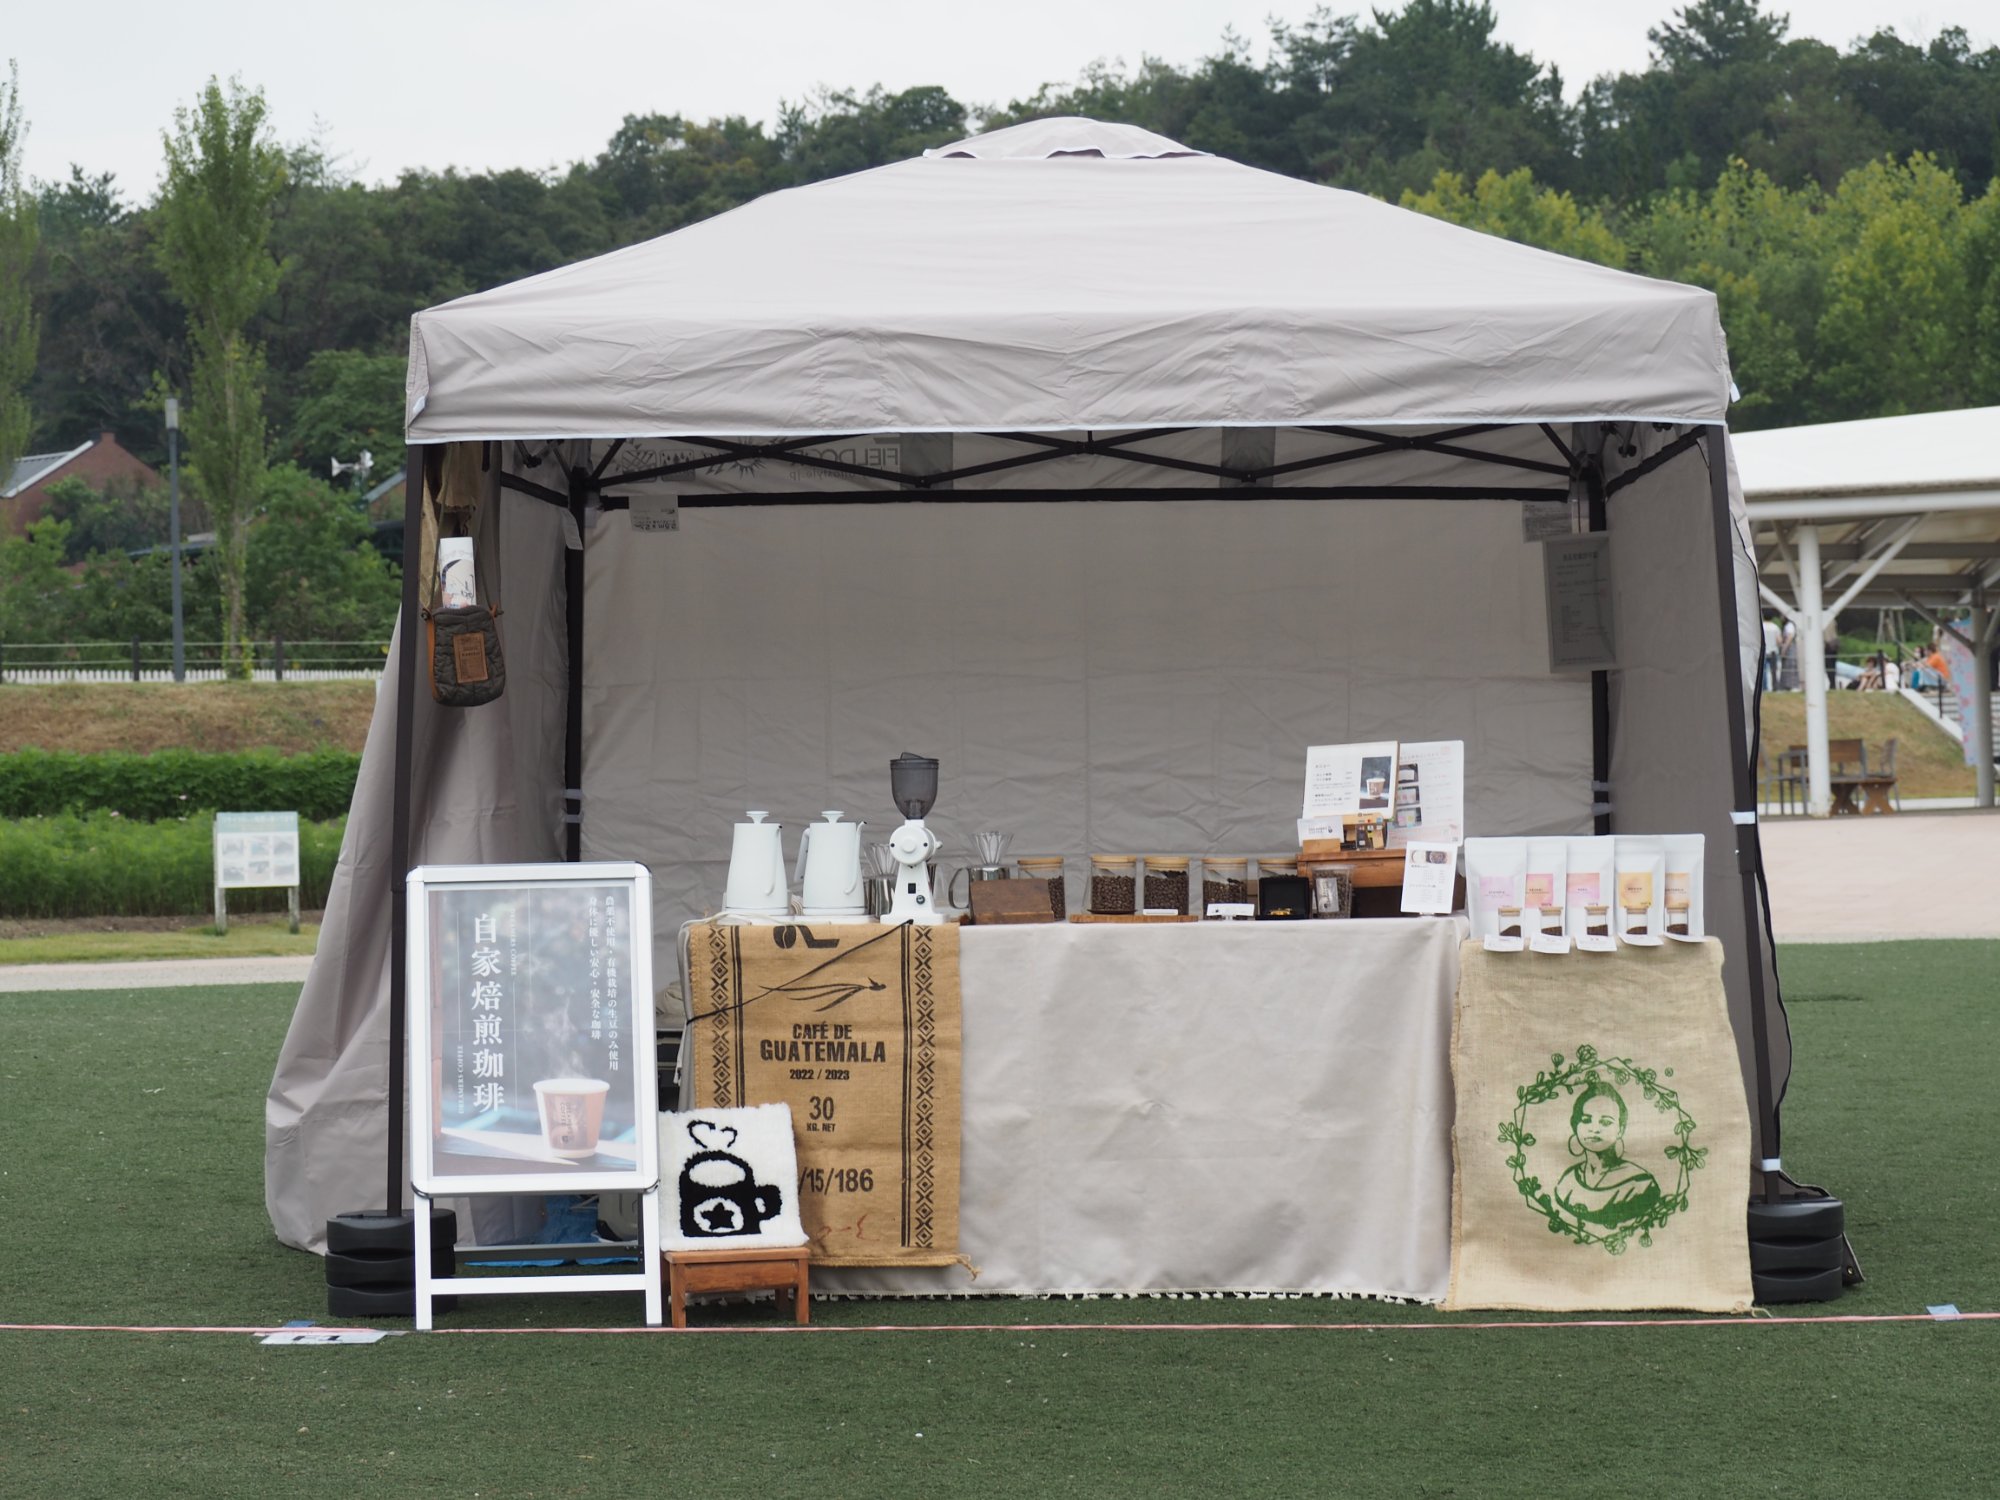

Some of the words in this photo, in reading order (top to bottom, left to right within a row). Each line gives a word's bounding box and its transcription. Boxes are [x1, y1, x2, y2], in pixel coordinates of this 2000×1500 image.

[588, 896, 602, 1040] 身体に優しい安心・安全な珈琲
[470, 913, 505, 1113] 自家焙煎珈琲
[792, 1021, 829, 1040] CAFÉ
[834, 1024, 853, 1040] DE
[760, 1039, 886, 1063] GUATEMALA
[789, 1068, 815, 1081] 2022
[825, 1068, 850, 1081] 2023
[809, 1096, 835, 1121] 30
